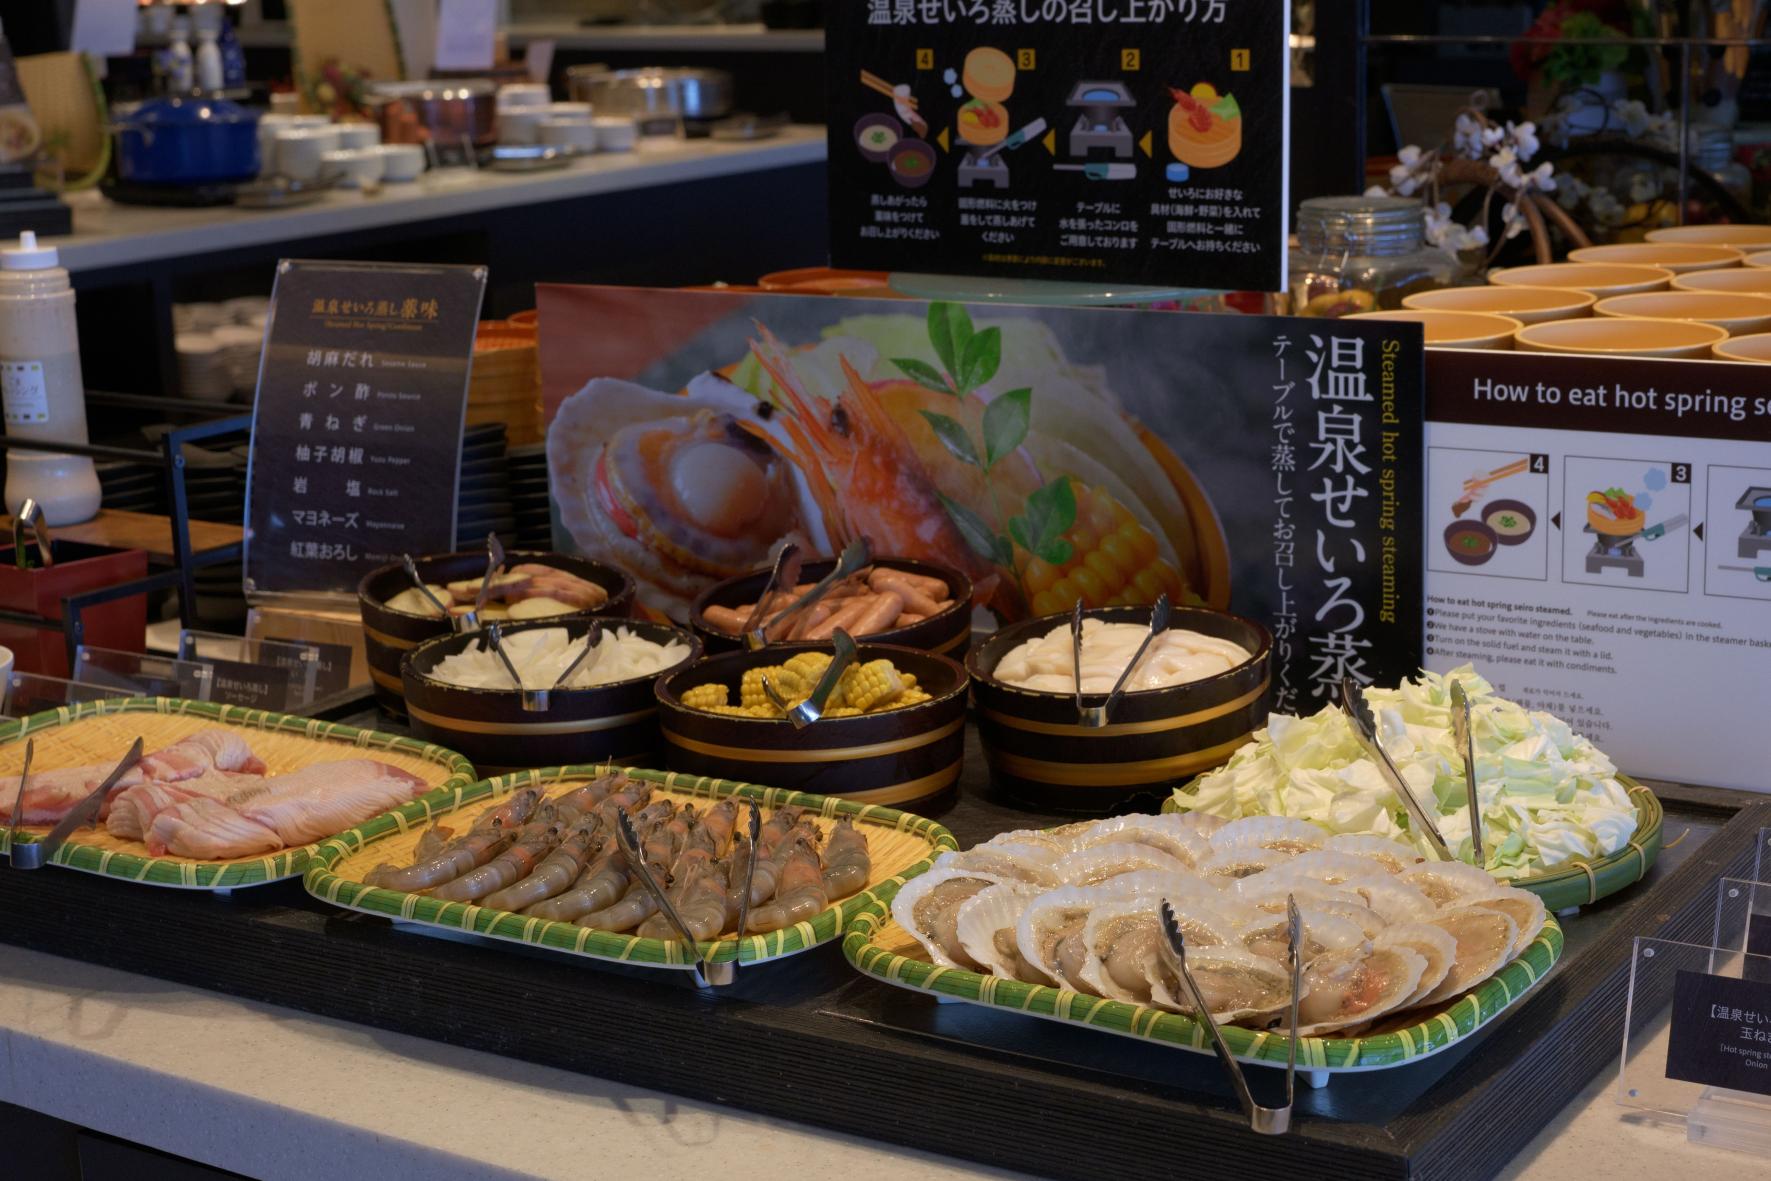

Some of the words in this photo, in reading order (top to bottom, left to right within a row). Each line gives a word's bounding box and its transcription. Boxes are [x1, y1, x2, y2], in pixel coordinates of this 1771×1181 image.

[867, 0, 1227, 25] 温泉せいろ蒸しの召し上がり方
[920, 52, 930, 67] 4
[1022, 52, 1031, 68] 3
[1125, 52, 1136, 68] 2
[1168, 187, 1243, 200] せいろにお好きな
[1076, 201, 1121, 214] テーブルに
[981, 230, 1015, 243] ください
[1059, 234, 1138, 248] ご用意しております
[1150, 237, 1261, 253] テーブルへお持ちください
[306, 349, 373, 368] 胡麻だれ
[1381, 340, 1400, 425] Steamed
[1473, 378, 1528, 403] How
[1536, 382, 1562, 404] to
[1568, 385, 1607, 407] eat
[1615, 384, 1657, 410] hot
[1665, 388, 1747, 421] spring
[295, 444, 364, 464] 柚子胡椒
[1381, 432, 1400, 464] hot
[1533, 457, 1545, 472] 4
[1675, 466, 1687, 481] 3
[1379, 469, 1400, 531] spring
[292, 510, 359, 529] マヨネーズ
[1271, 335, 1299, 712] テーブルで蒸してお召し上がりくだ
[290, 540, 358, 561] 紅葉おろし
[1379, 537, 1400, 624] steaming
[1427, 595, 1445, 604] How
[1457, 598, 1469, 606] eat
[1472, 598, 1485, 607] hot
[1487, 600, 1512, 612] spring
[1514, 601, 1534, 611] seiro
[1448, 624, 1467, 632] have
[1476, 626, 1497, 635] stove
[1499, 628, 1517, 637] with
[1518, 630, 1541, 640] water
[1543, 632, 1553, 641] on
[1555, 633, 1569, 642] the
[1571, 635, 1595, 646] table.
[1462, 611, 1475, 620] put
[1477, 613, 1495, 622] your
[1497, 613, 1528, 625] favorite
[1530, 617, 1576, 630] ingredients
[1578, 621, 1614, 634] (seafood
[1616, 626, 1632, 635] and
[1634, 628, 1682, 641] vegetables)
[1685, 631, 1695, 640] in
[1696, 633, 1710, 643] the
[1712, 635, 1747, 646] steamer
[1749, 638, 1771, 648] bask
[1455, 637, 1465, 645] on
[1467, 638, 1480, 647] the
[1482, 639, 1501, 649] solid
[1503, 641, 1519, 651] fuel
[1521, 643, 1537, 652] and
[1538, 645, 1563, 655] steam
[1565, 646, 1571, 655] it
[1573, 647, 1591, 657] with
[1600, 650, 1613, 660] lid.
[1496, 655, 1522, 665] please
[1524, 657, 1537, 666] eat
[1538, 657, 1544, 666] it
[1546, 658, 1564, 669] with
[1566, 660, 1617, 673] condiments.
[1710, 1004, 1771, 1024] 【温泉せい
[1738, 1048, 1762, 1060] spring
[1745, 1059, 1768, 1069] Onion
